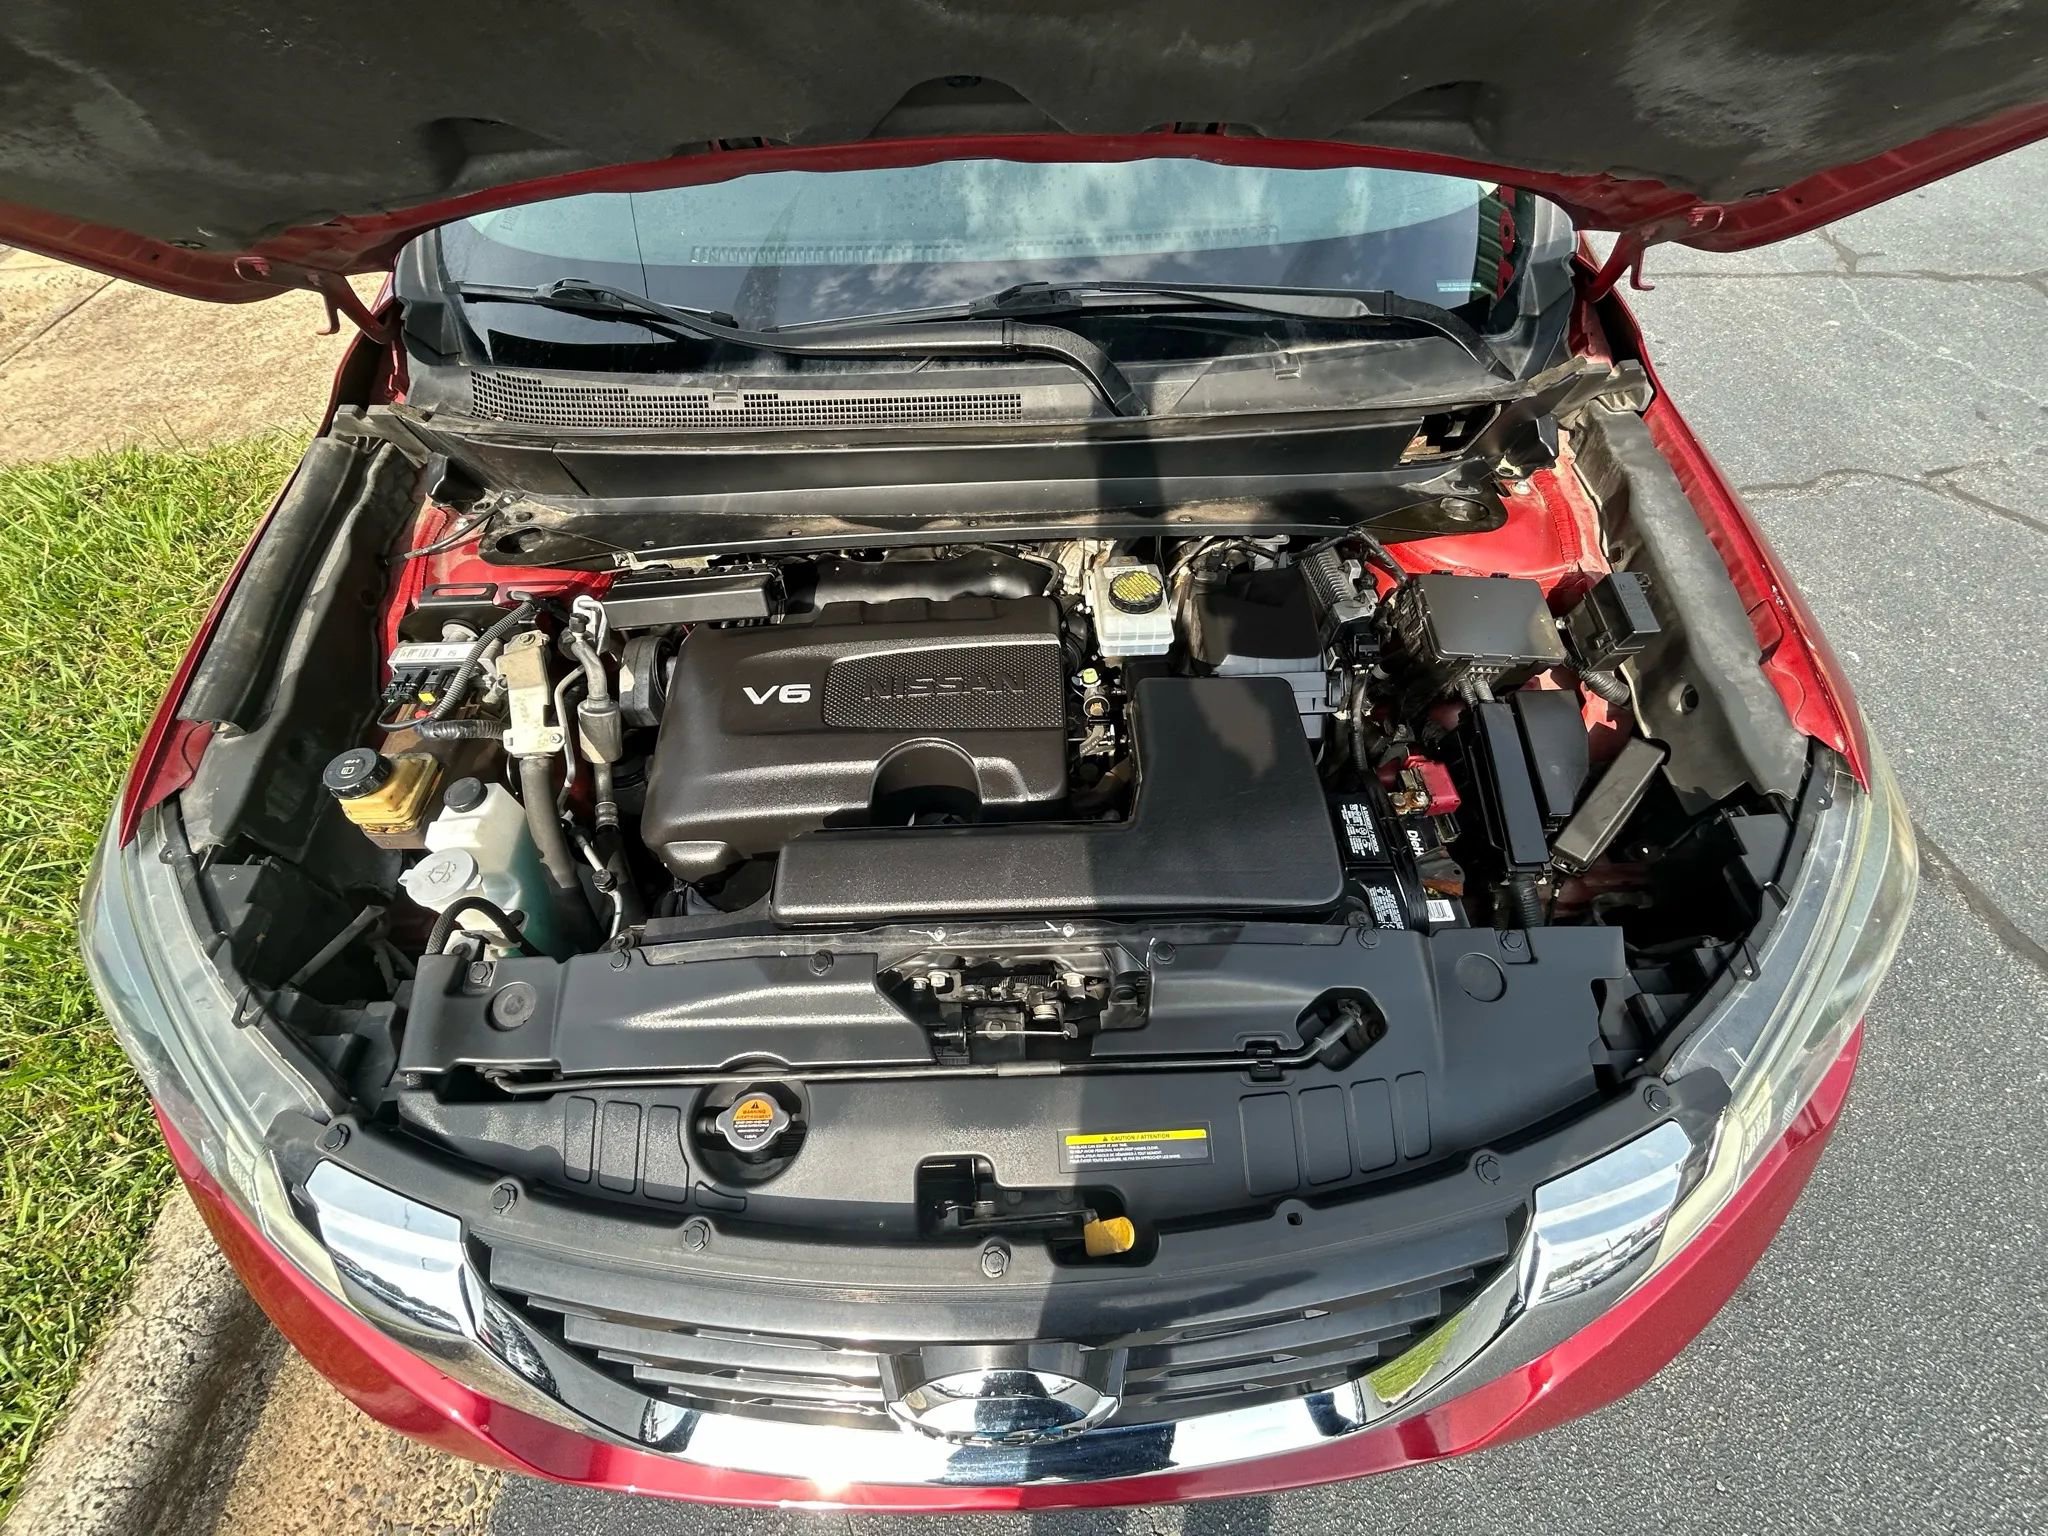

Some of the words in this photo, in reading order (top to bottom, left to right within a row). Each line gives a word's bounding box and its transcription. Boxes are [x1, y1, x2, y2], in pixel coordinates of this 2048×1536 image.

[742, 684, 811, 705] V6
[863, 671, 1025, 699] NISSAN
[1407, 830, 1424, 857] DieH
